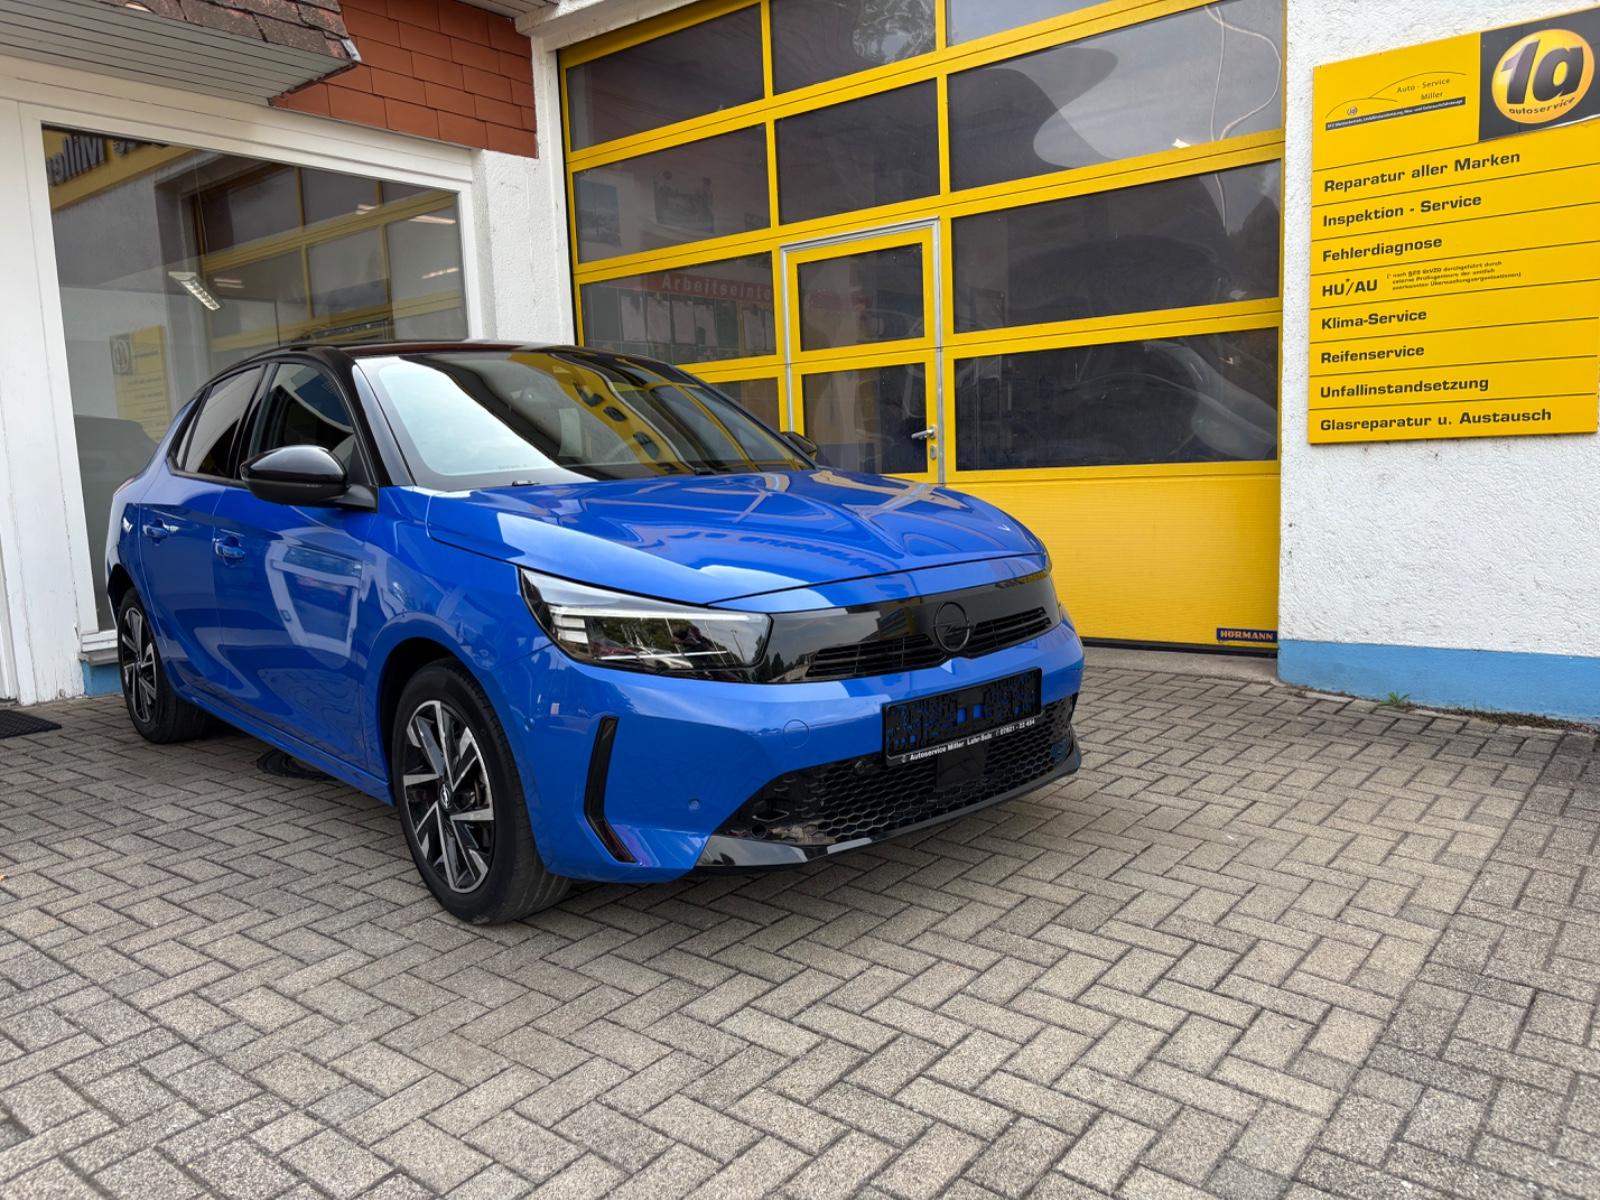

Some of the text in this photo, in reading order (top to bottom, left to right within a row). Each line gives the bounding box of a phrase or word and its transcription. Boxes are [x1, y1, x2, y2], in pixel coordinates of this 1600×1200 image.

[1501, 39, 1584, 105] 1a
[1396, 85, 1416, 94] Auto
[1422, 78, 1451, 88] Service
[1421, 91, 1444, 100] Miller
[1508, 97, 1576, 115] autoservice
[1324, 152, 1521, 193] Reparatur aller Marken
[1323, 205, 1404, 227] Inspektion
[1420, 195, 1482, 213] Service
[1322, 237, 1443, 262] Fehlerdiagnose
[1321, 309, 1428, 330] Klima-Service
[1320, 345, 1425, 364] Reifenservice
[1320, 378, 1489, 399] Unfallinstandsetzung
[1320, 408, 1552, 432] Glasreparatur u. Austausch
[910, 745, 947, 761] Autoservice
[947, 741, 965, 751] Miller
